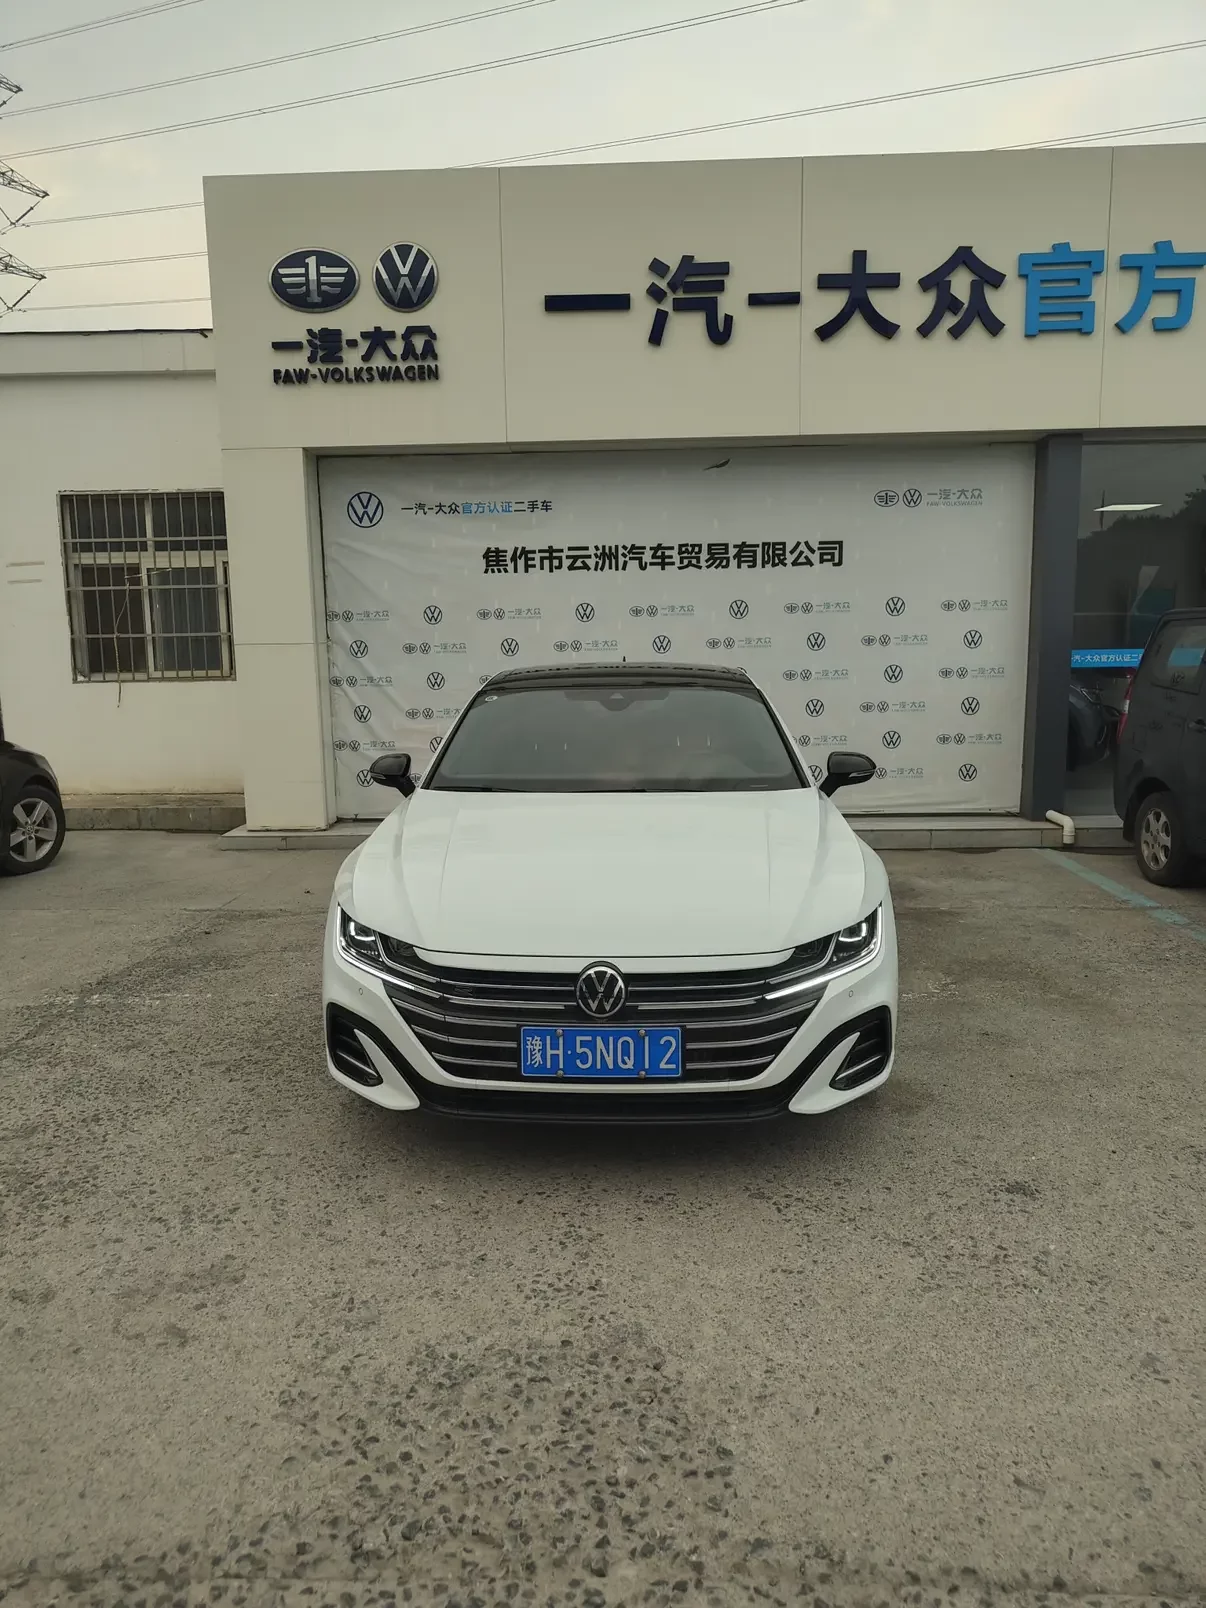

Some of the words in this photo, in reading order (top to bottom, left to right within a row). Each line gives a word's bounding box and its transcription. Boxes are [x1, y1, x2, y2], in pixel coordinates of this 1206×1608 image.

[544, 239, 1206, 346] 一汽-大众官方
[273, 364, 440, 385] FAW-VOLKSWAGEN
[401, 500, 553, 515] 一汽-大众官方认证二手车
[482, 540, 844, 574] 焦作市云洲汽车贸易有限公司
[1071, 653, 1143, 662] 汽-大众官方认证二
[526, 1035, 677, 1069] 豫H·5NQ12
